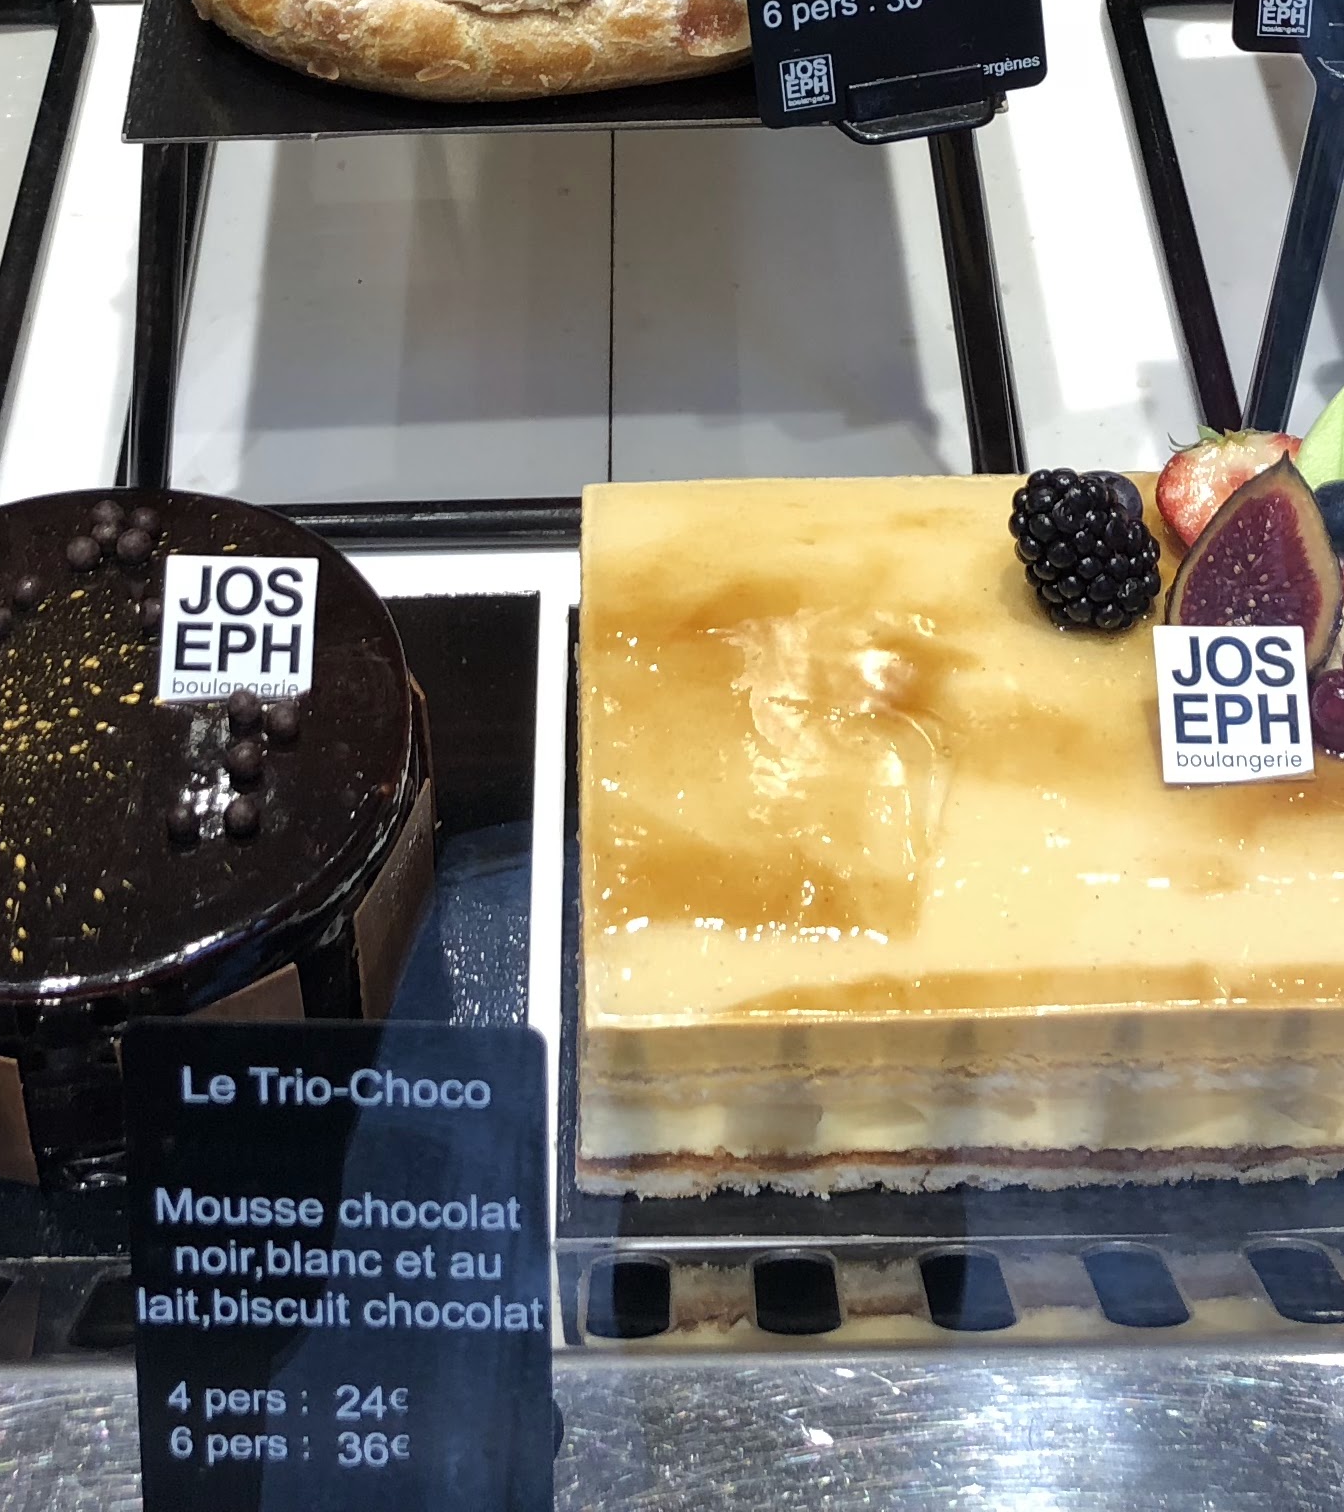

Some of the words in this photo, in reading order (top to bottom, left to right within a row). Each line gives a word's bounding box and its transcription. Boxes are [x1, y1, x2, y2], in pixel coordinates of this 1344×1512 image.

[764, 1, 782, 28] 6
[1262, 7, 1306, 25] EPH
[785, 57, 827, 82] JOS
[786, 76, 829, 99] EPH
[179, 564, 304, 617] JOS
[174, 621, 302, 674] EPH
[1171, 636, 1295, 688] JOS
[1173, 693, 1300, 744] EPH
[1176, 750, 1302, 773] boulangerie
[182, 1066, 235, 1104] Le
[249, 1067, 491, 1109] Trio-Choco
[156, 1187, 323, 1226] Mousse
[340, 1192, 521, 1231] chocolat
[396, 1245, 436, 1278] et
[450, 1252, 501, 1279] au
[364, 1293, 544, 1330] chocolat
[168, 1381, 191, 1411] 4
[205, 1389, 286, 1419] pers
[336, 1385, 408, 1420] 24€
[171, 1427, 193, 1456] 6
[208, 1434, 287, 1465] pers
[338, 1432, 409, 1467] 36€
